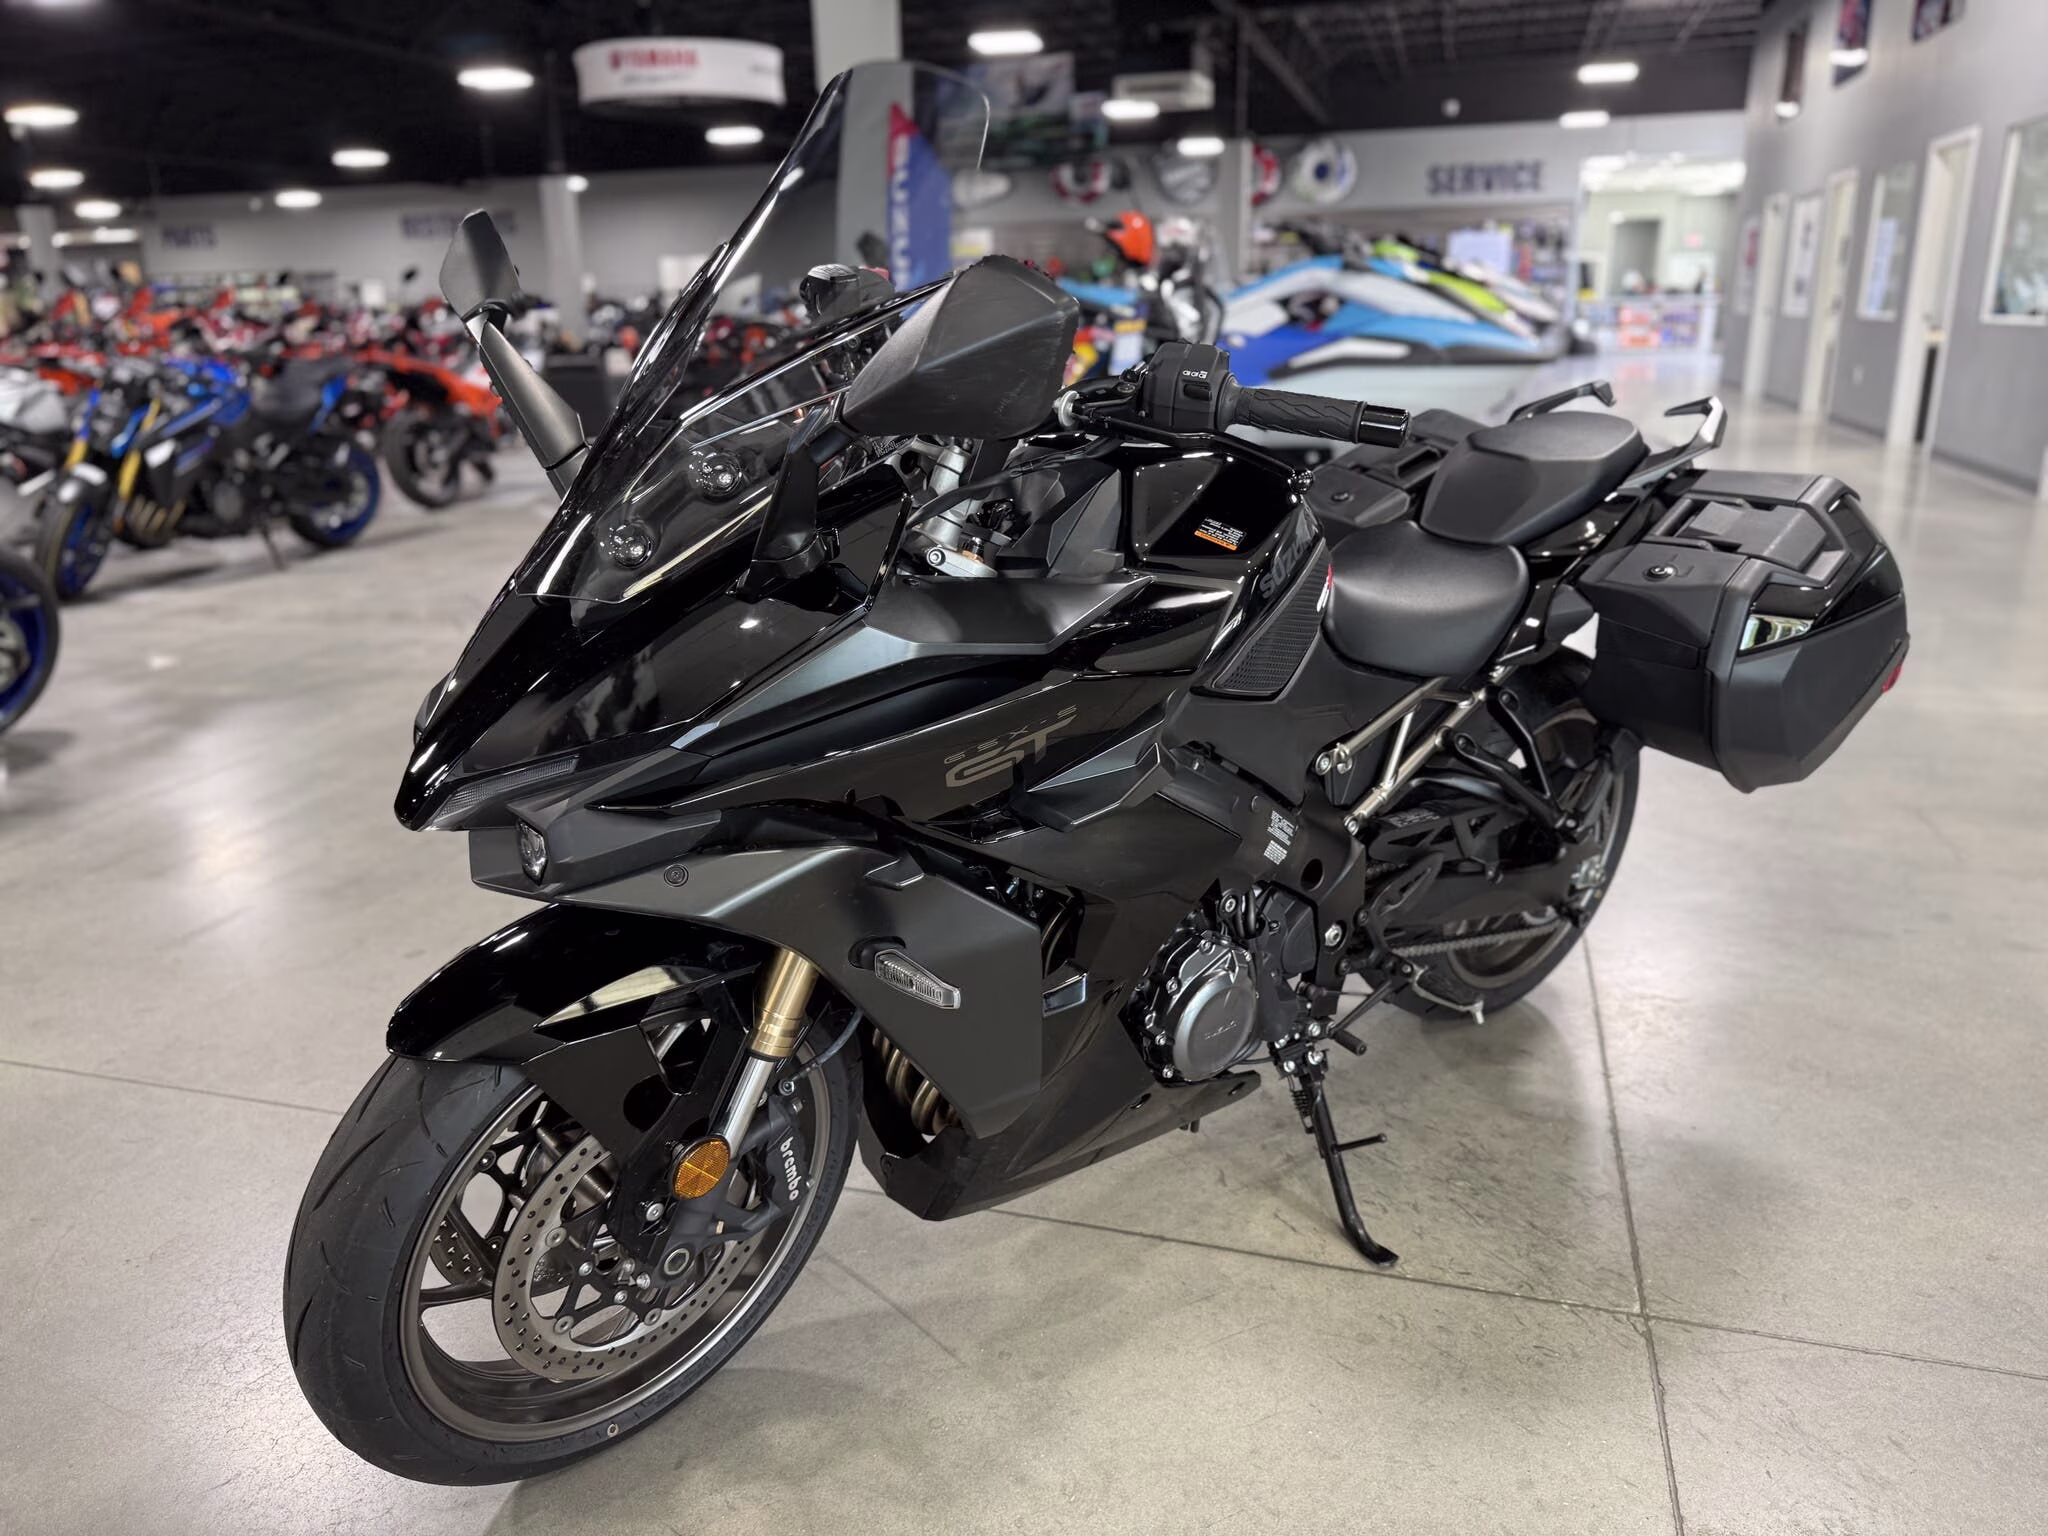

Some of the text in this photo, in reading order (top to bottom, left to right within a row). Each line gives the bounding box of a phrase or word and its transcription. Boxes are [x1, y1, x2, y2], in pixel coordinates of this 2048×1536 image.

[1427, 160, 1546, 196] SERVICE
[946, 715, 1078, 787] GT
[780, 1136, 802, 1201] brembo
